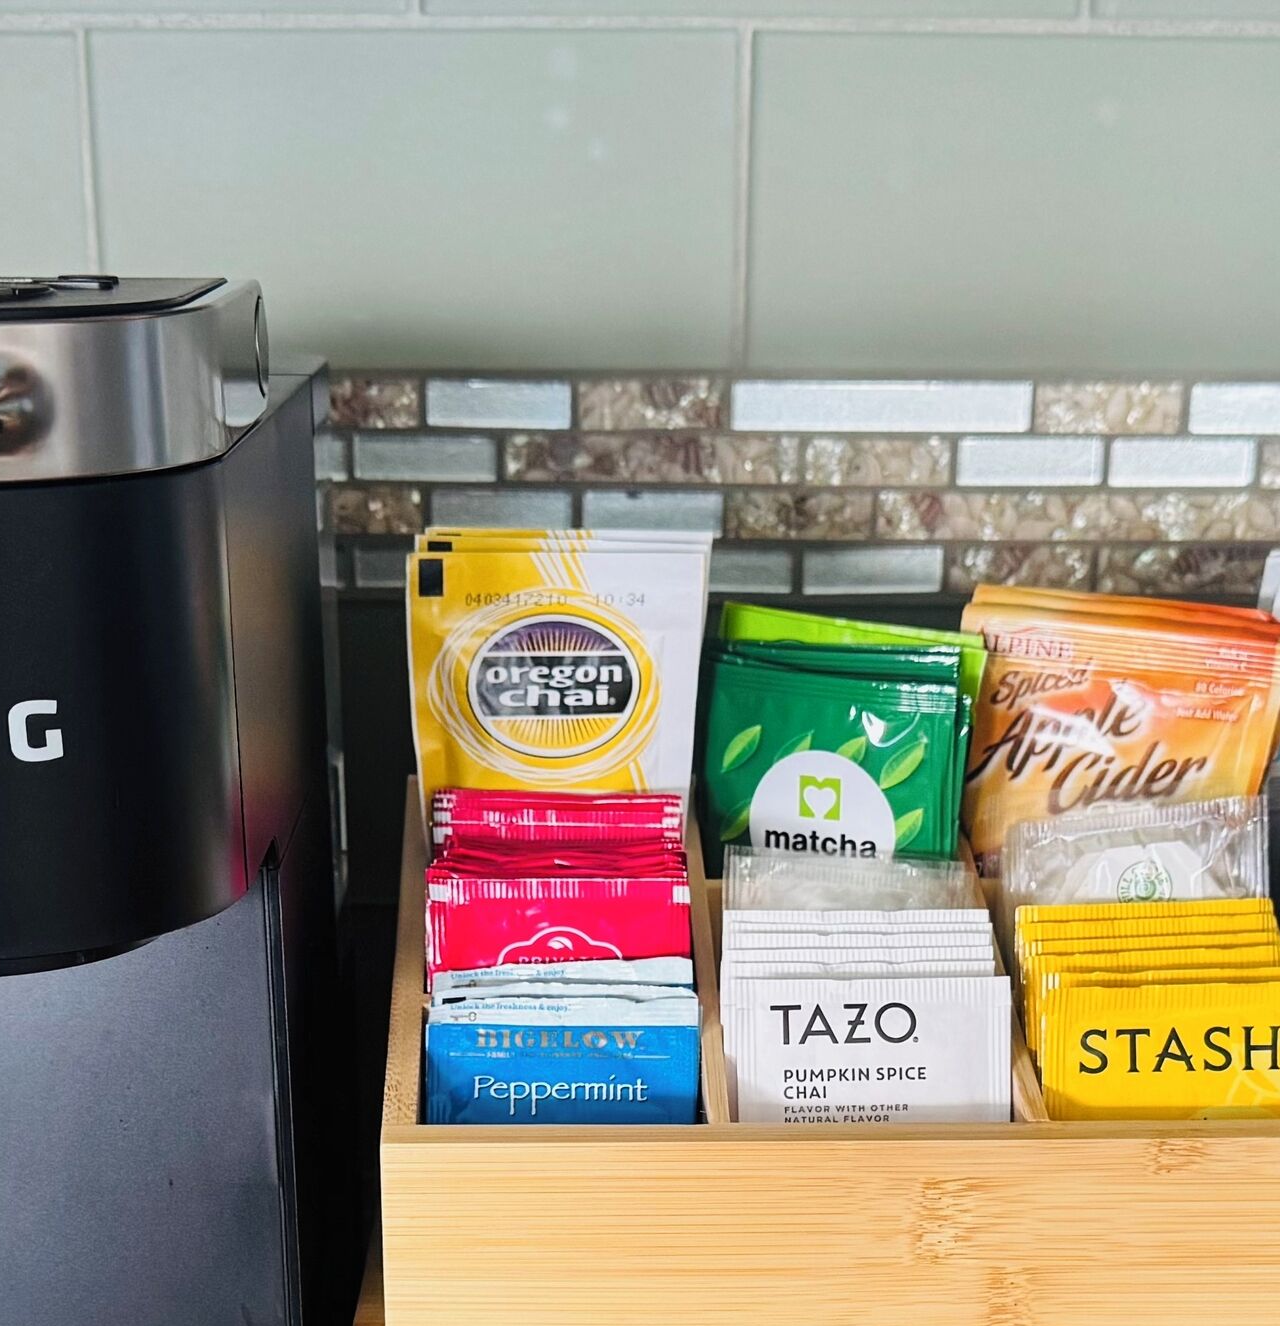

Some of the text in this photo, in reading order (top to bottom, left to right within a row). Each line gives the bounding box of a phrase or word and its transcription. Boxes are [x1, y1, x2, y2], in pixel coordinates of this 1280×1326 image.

[485, 665, 622, 688] oregon
[991, 658, 1092, 708] Spiced
[1047, 742, 1207, 815] Cider
[765, 829, 877, 858] matcha
[770, 1002, 917, 1045] TAZO
[476, 1029, 644, 1049] BIGELOW
[1079, 1026, 1280, 1074] STASH
[783, 1067, 927, 1082] PUMPKIN SPICE
[474, 1074, 648, 1115] Peppermint
[783, 1086, 827, 1099] CHAI
[784, 1106, 830, 1114] FLAVOR
[871, 1104, 909, 1112] OTHER
[784, 1115, 838, 1123] NATURAL
